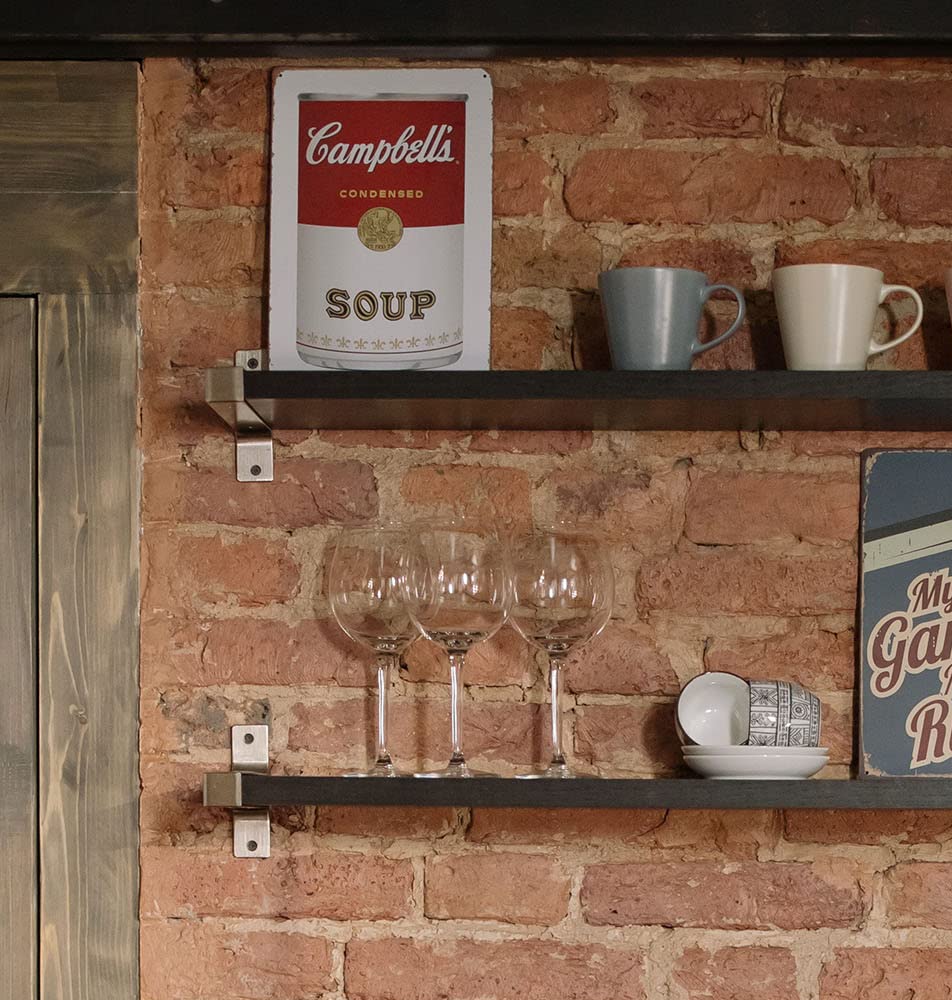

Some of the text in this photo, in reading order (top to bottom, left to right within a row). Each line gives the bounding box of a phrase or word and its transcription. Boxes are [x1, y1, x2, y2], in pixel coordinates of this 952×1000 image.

[305, 121, 455, 173] Campbell's
[339, 189, 424, 199] CONDENSED
[325, 287, 436, 322] SOUP
